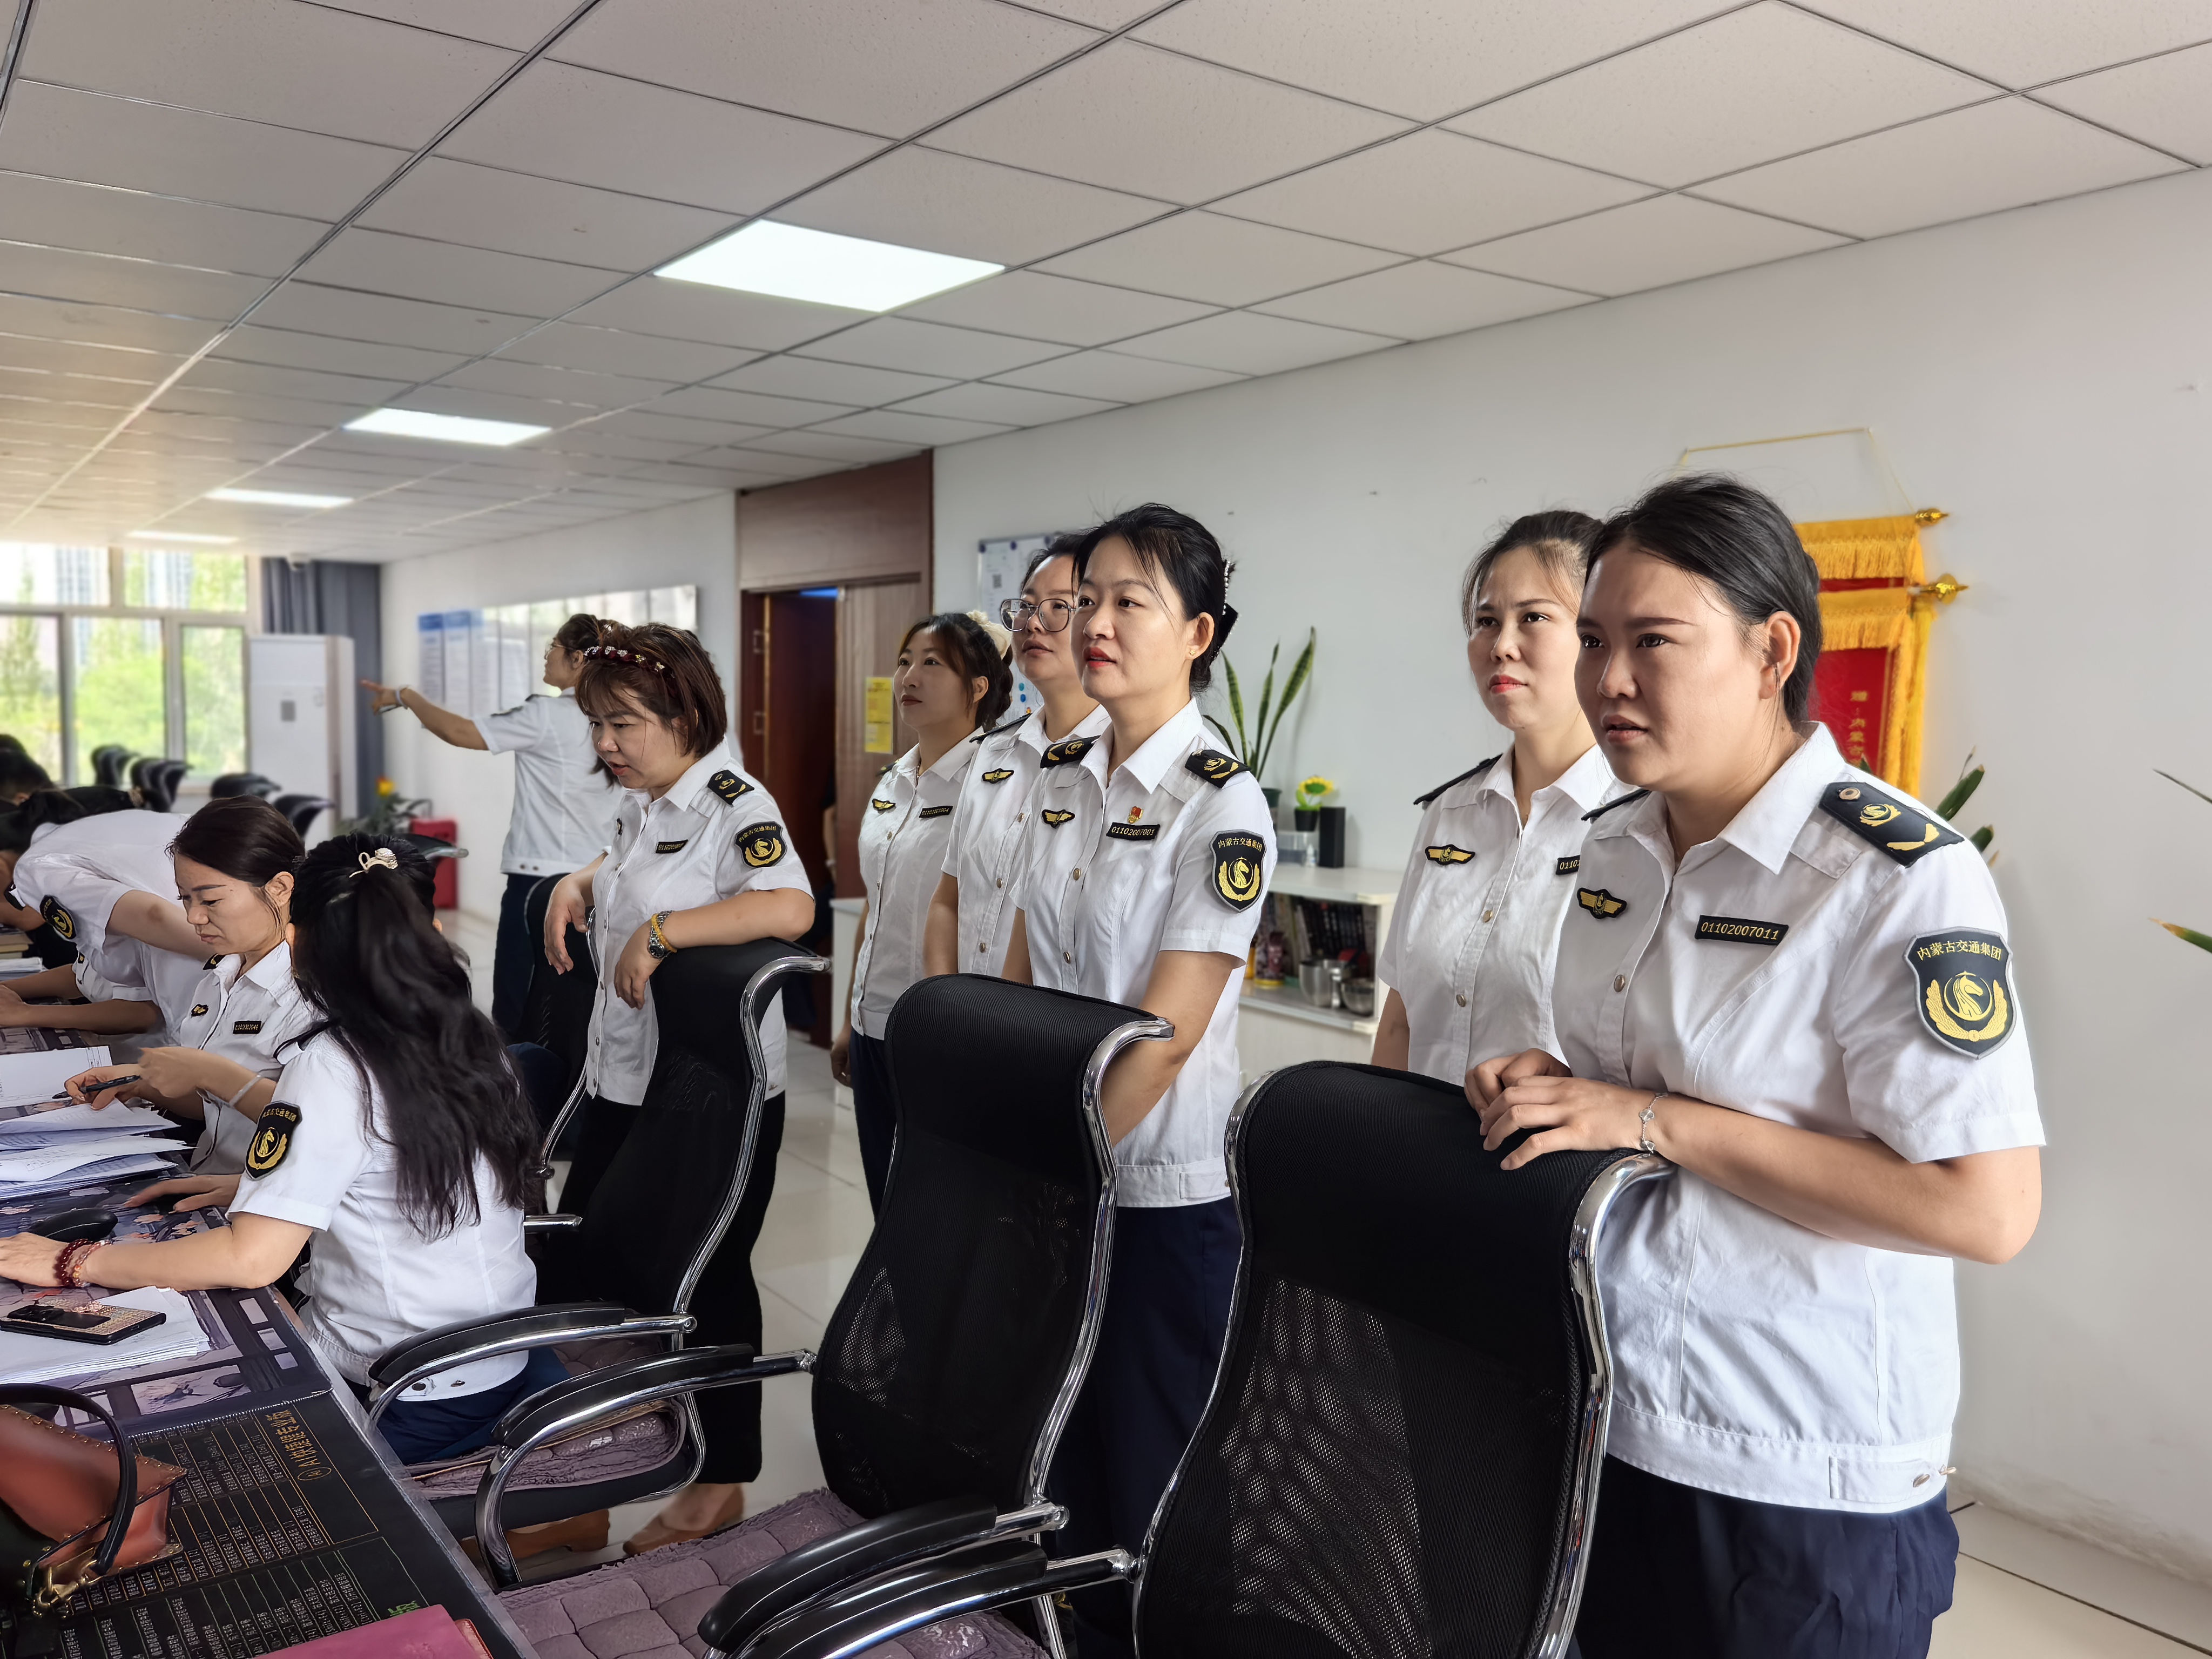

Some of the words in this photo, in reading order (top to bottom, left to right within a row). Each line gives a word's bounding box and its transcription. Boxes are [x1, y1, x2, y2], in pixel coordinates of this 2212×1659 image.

[1218, 837, 1263, 852] 内蒙古交通集团
[1701, 922, 1779, 940] 01102007011
[1917, 939, 2002, 961] 内蒙古交通集团
